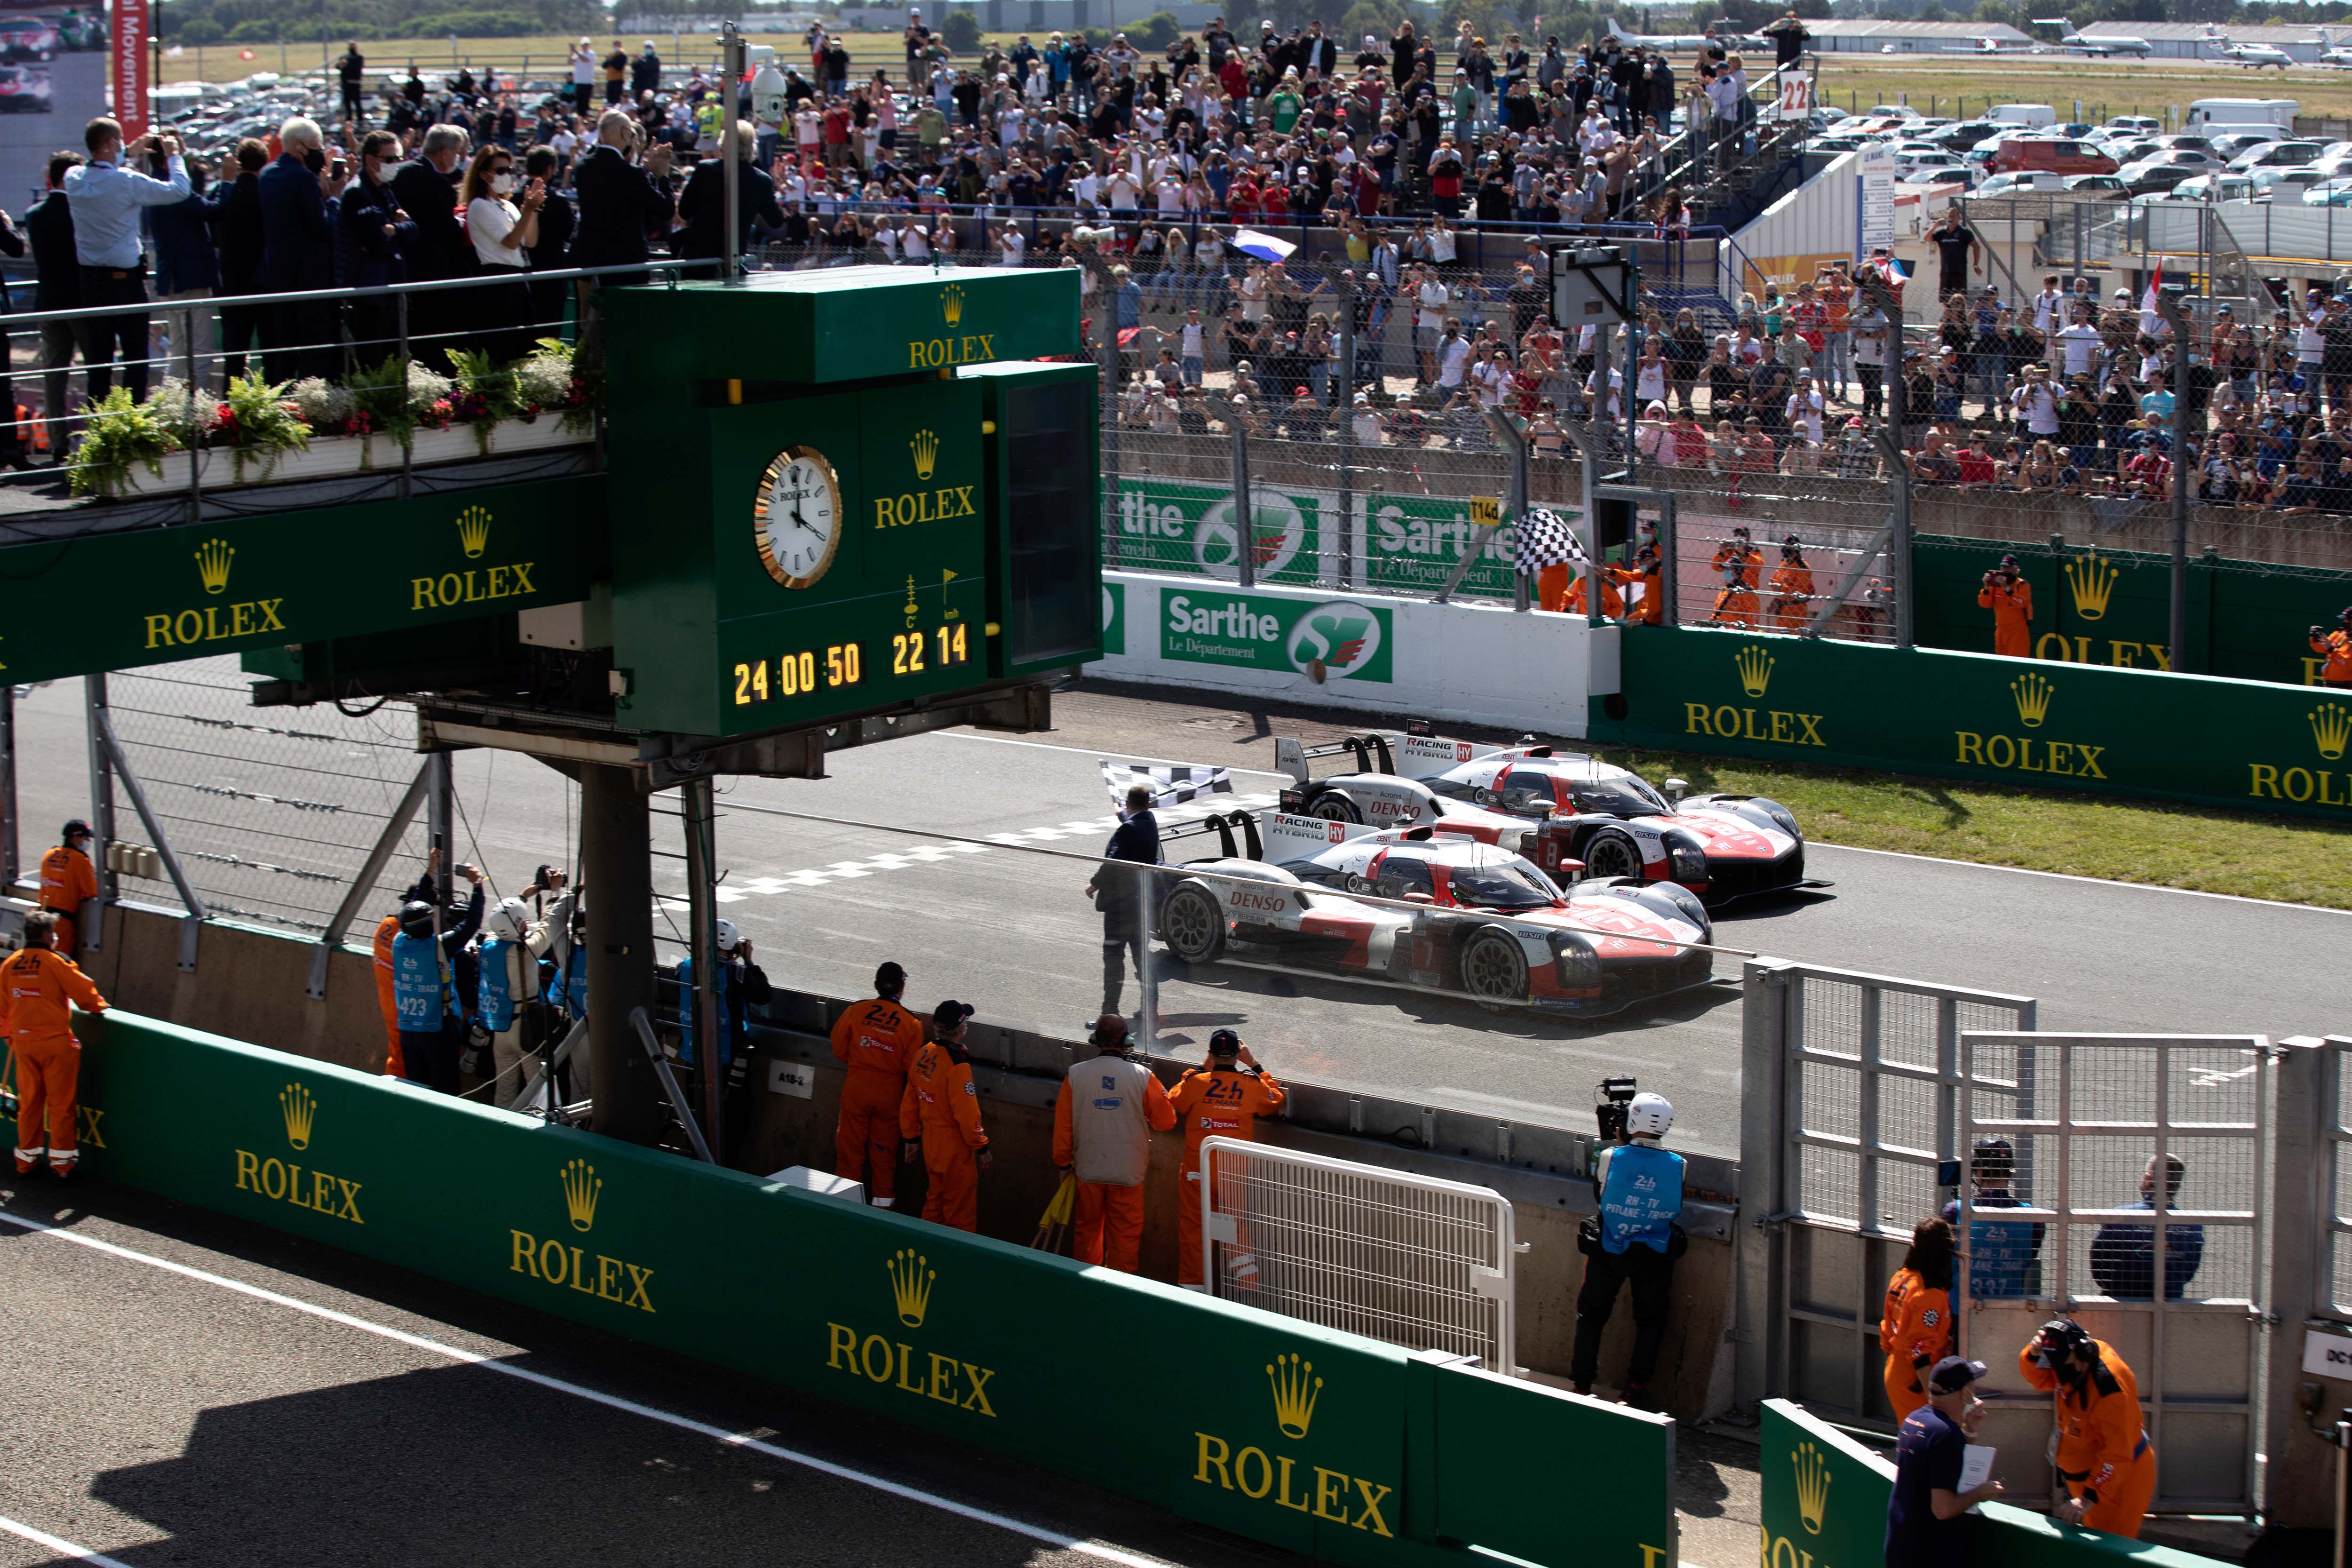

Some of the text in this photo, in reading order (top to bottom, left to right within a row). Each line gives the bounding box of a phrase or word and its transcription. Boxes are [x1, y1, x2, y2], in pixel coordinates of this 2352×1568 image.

[121, 16, 140, 122] Movement
[1783, 80, 1806, 111] 22
[908, 334, 995, 368] ROLEX
[779, 488, 810, 501] ROLEX
[874, 486, 976, 529] ROLEX
[1472, 501, 1498, 520] T14d
[410, 562, 537, 611] ROLEX
[144, 598, 286, 649] ROLEX
[1168, 596, 1279, 642] Sarthe
[893, 632, 924, 674] 22
[937, 623, 966, 664] 14
[1168, 636, 1255, 659] Le Département
[1685, 702, 1827, 747] ROLEX
[1405, 746, 1453, 760] HYBRID
[1407, 738, 1452, 750] RACING
[1458, 745, 1470, 760] HY
[1955, 730, 2108, 780] ROLEX
[1379, 791, 1402, 799] Acronis
[2248, 763, 2352, 806] ROL
[1370, 801, 1421, 819] DENSO
[1272, 825, 1325, 840] HYBRID
[1274, 815, 1323, 830] RACING
[1330, 827, 1344, 841] HY
[1547, 842, 1557, 867] 8
[1240, 883, 1264, 891] Acronis
[1230, 891, 1285, 912] DENSO
[400, 996, 427, 1017] 423
[865, 1004, 901, 1027] 24h
[870, 1040, 895, 1051] TOTAL
[778, 1072, 804, 1087] A18-2
[1205, 1078, 1243, 1099] 24h
[234, 1148, 365, 1225] ROLEX
[1605, 1203, 1639, 1218] PITLANE
[1648, 1210, 1675, 1220] TRACK
[1625, 1195, 1638, 1206] RH
[1647, 1198, 1660, 1209] TV
[509, 1229, 656, 1313] ROLEX
[826, 1321, 997, 1418] ROLEX
[1193, 1431, 1394, 1538] ROLEX
